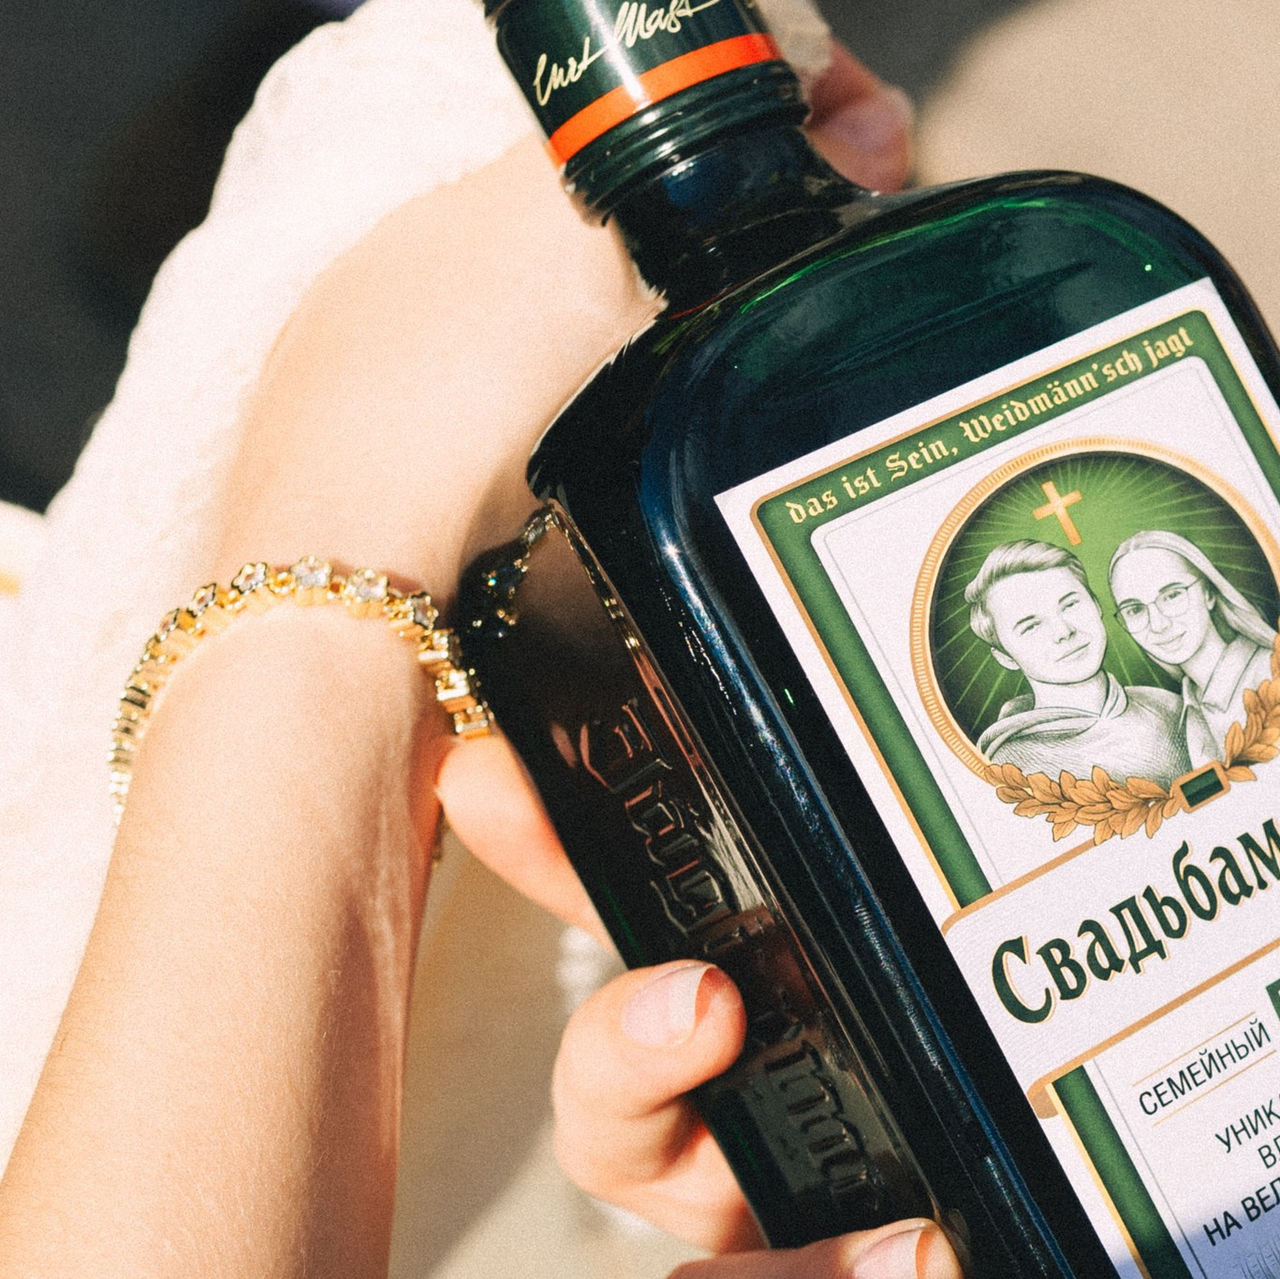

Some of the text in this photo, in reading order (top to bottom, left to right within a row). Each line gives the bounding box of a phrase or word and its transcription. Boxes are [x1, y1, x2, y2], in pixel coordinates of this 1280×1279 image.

[786, 488, 838, 524] das
[842, 466, 881, 500] ist
[885, 435, 959, 481] Sein,
[1143, 326, 1194, 369] jagt
[1138, 1018, 1272, 1116] СЕМЕЙНЫЙ
[1203, 1211, 1242, 1247] НА
